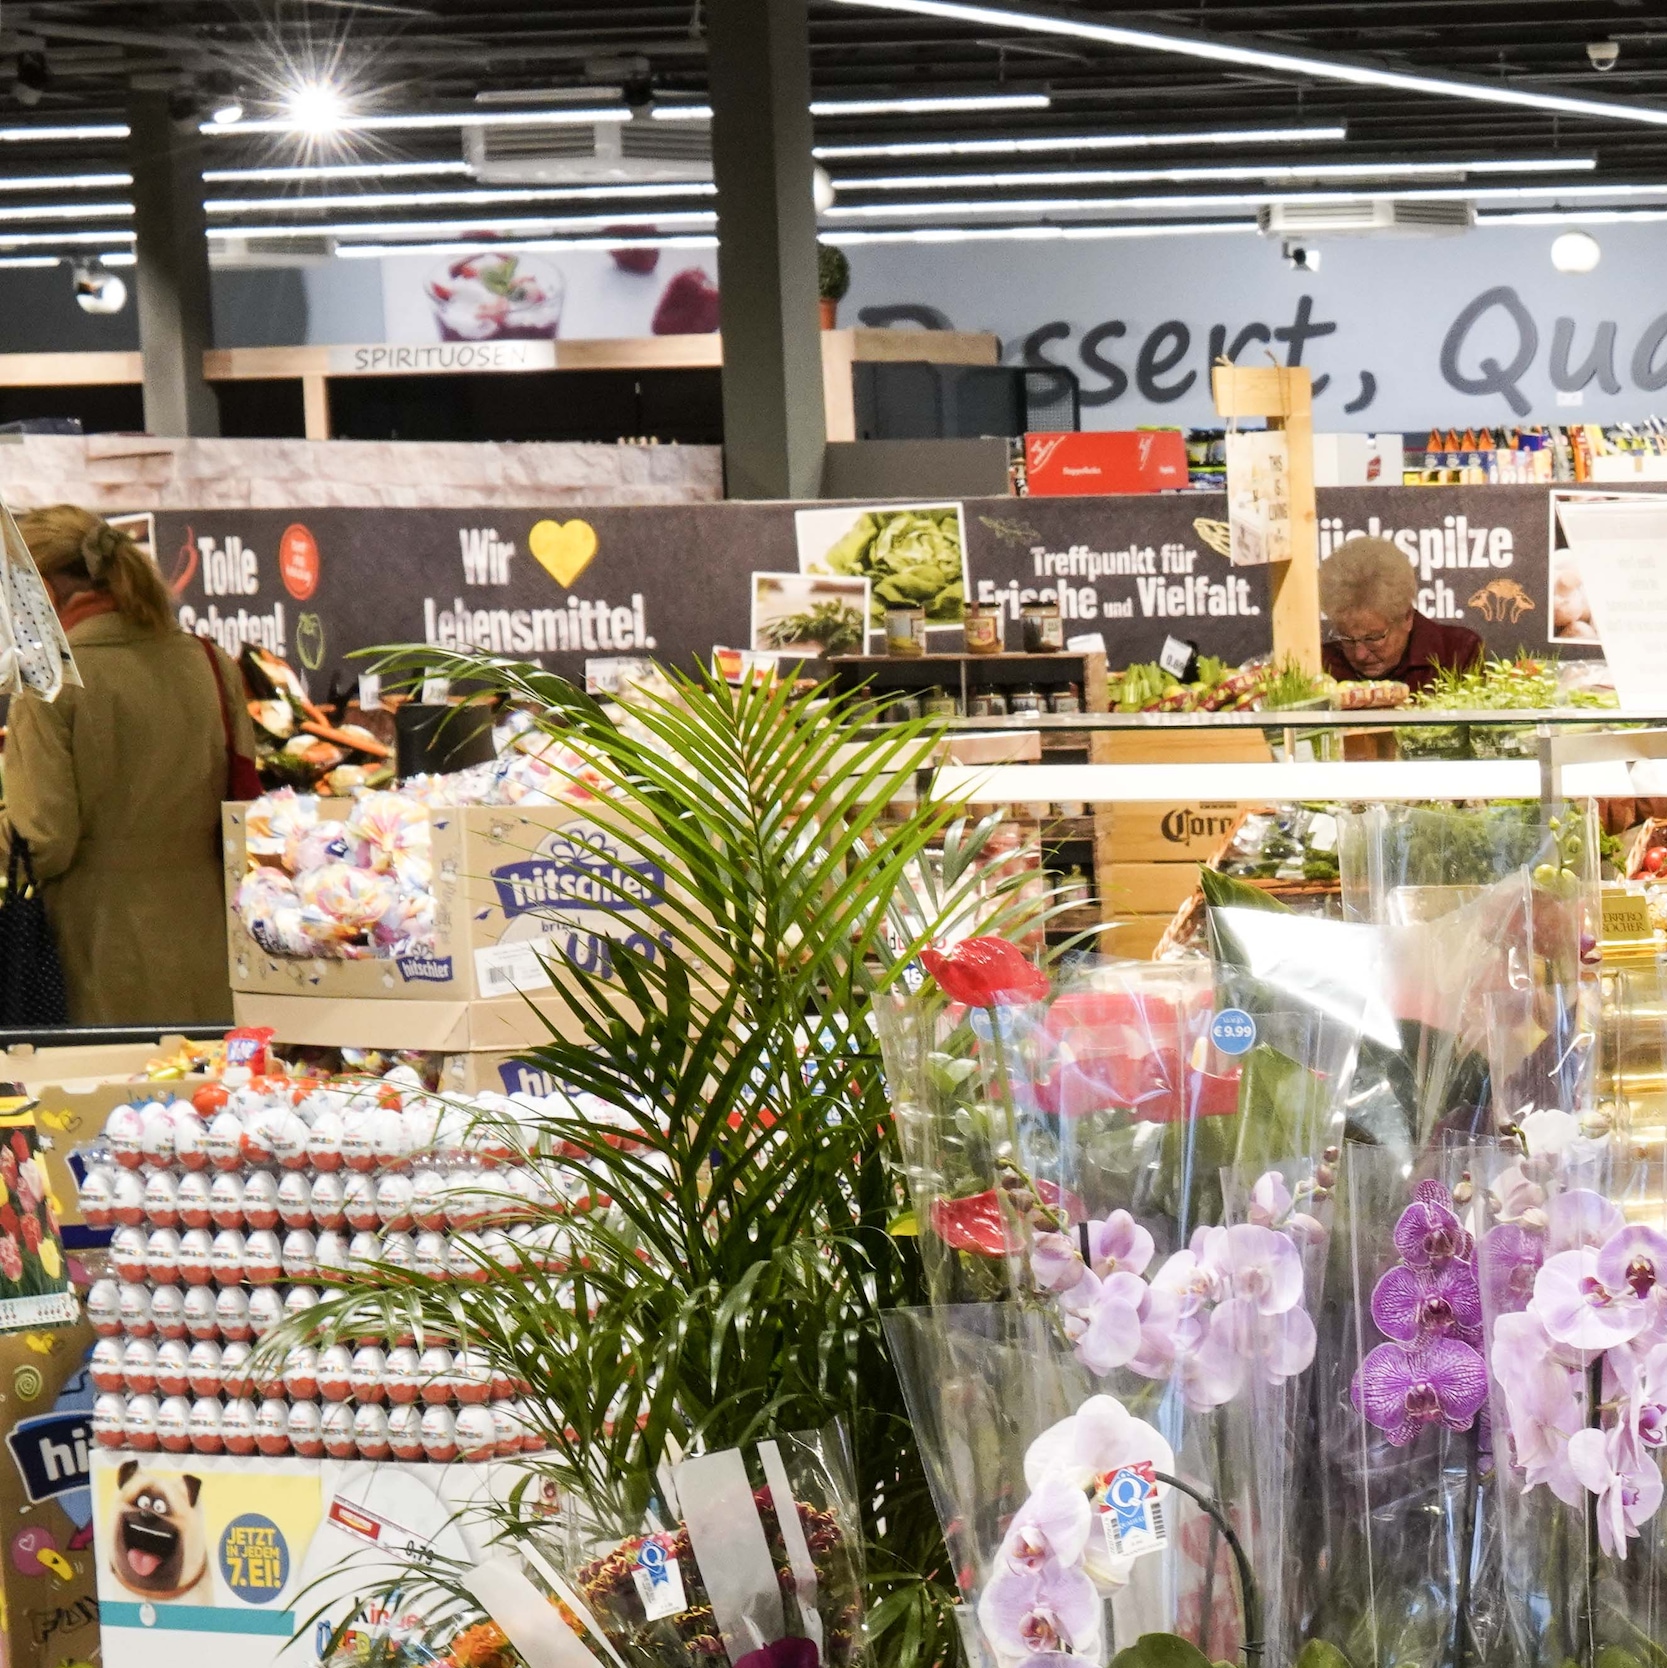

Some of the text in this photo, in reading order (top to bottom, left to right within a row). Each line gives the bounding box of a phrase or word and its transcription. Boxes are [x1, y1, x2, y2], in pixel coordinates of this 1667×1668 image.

[354, 344, 527, 370] SPIRITUOSEN
[197, 535, 260, 596] Tolle
[458, 527, 516, 585] Wir
[1030, 543, 1198, 581] Treffpunkt für
[1103, 597, 1135, 618] und
[1136, 575, 1261, 617] Vielfalt.
[228, 1526, 276, 1545] JETZT
[226, 1546, 280, 1560] IN JEDEM
[405, 1539, 435, 1567] 0.79
